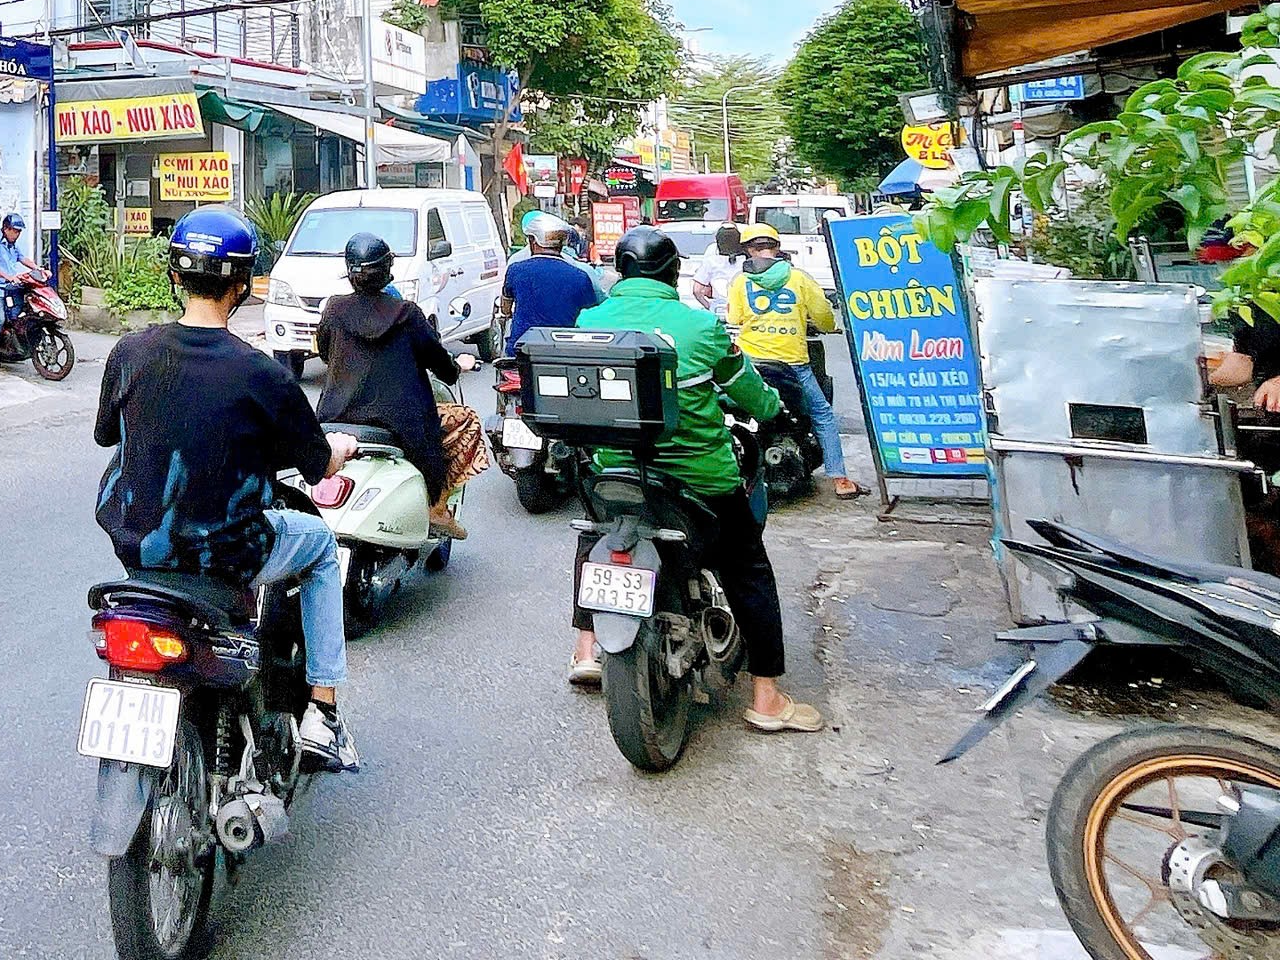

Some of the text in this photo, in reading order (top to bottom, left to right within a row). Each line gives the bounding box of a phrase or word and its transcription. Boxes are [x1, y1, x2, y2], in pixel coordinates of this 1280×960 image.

[59, 107, 77, 136] MÌ
[81, 105, 112, 136] XÀO
[126, 106, 157, 133] NUI
[159, 99, 196, 131] XÀO
[177, 176, 198, 188] NUI
[854, 226, 924, 274] BỘT
[746, 280, 797, 315] be
[848, 278, 957, 320] CHIÊN
[861, 329, 964, 362] Kim Loan
[868, 372, 906, 387] 15/44
[593, 567, 642, 590] 59-S3
[585, 586, 648, 612] 283.52
[88, 719, 167, 759] 011.13
